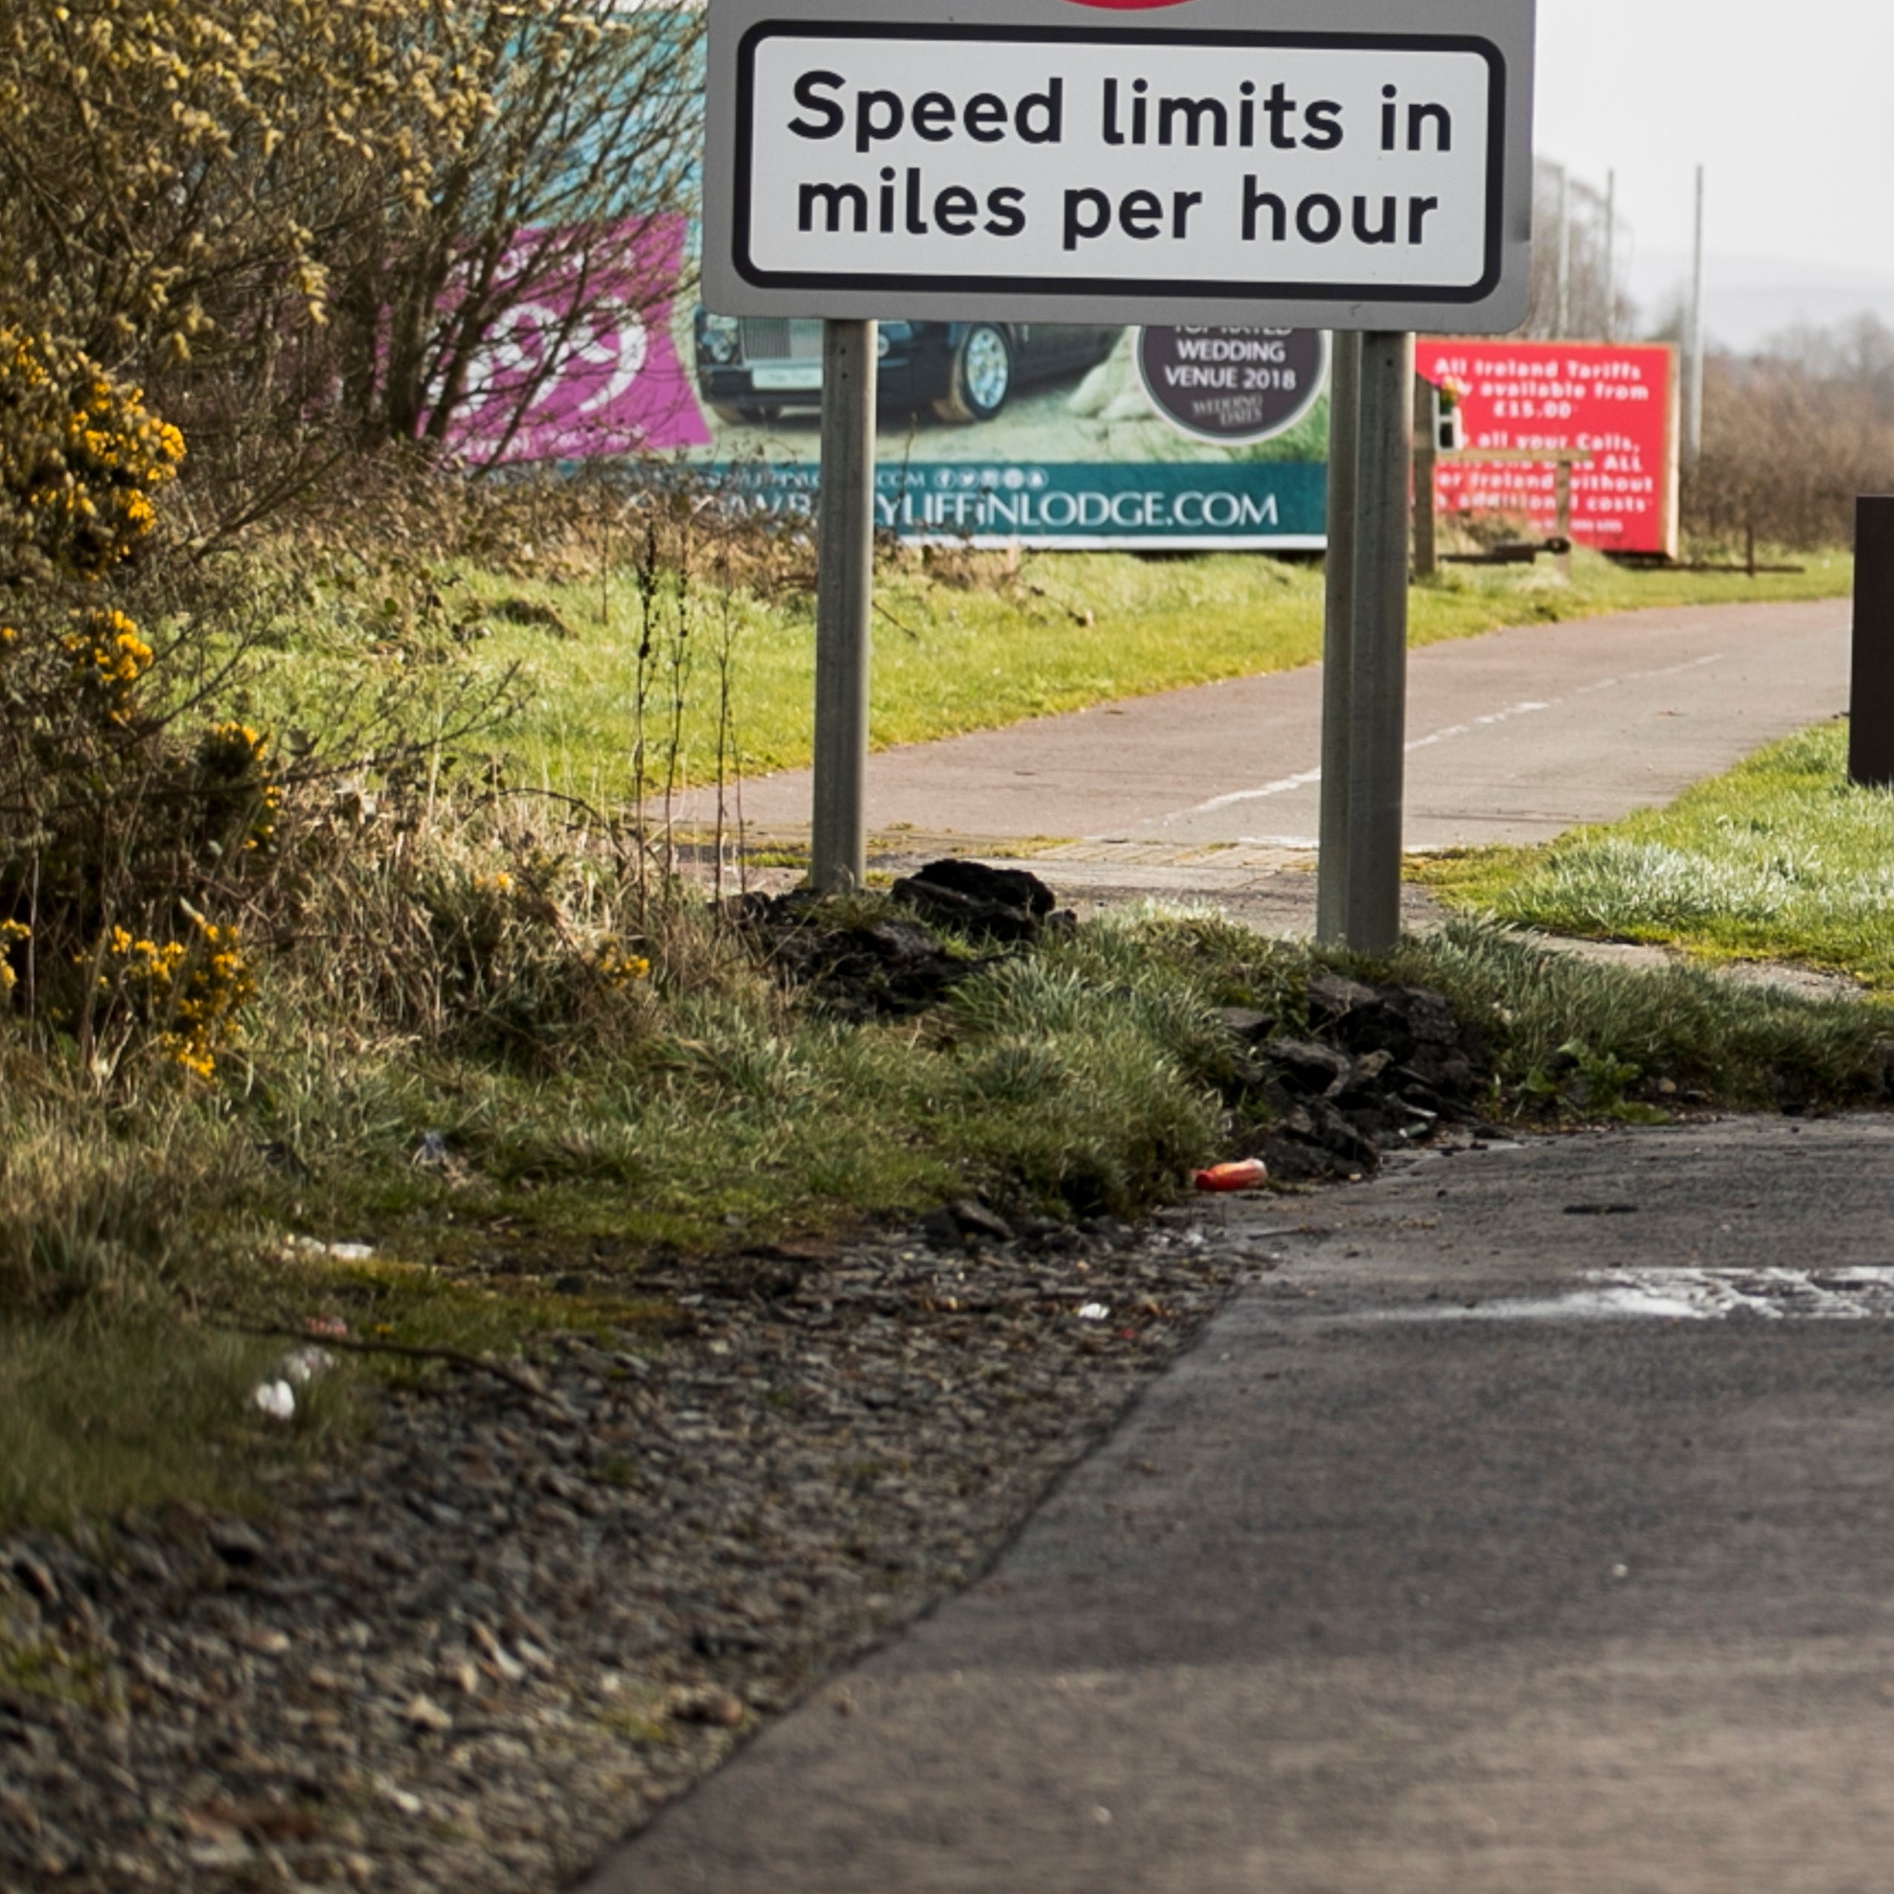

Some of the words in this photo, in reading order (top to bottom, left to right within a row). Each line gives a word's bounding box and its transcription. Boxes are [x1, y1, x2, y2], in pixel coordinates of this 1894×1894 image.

[787, 70, 1063, 153] Speed
[1102, 77, 1344, 151] limits
[1381, 83, 1452, 152] in
[798, 166, 1026, 238] miles
[1062, 186, 1203, 252] per
[1241, 174, 1438, 245] hour
[1177, 339, 1286, 362] WEDDING
[1164, 365, 1237, 388] VENUE
[1243, 367, 1296, 390] 2018
[1434, 358, 1467, 375] All
[1475, 359, 1558, 377] Ireland
[1566, 360, 1641, 379] Tariffs
[1480, 380, 1586, 398] available
[1594, 382, 1649, 400] from
[1478, 430, 1508, 448] all
[1516, 434, 1568, 449] your
[1468, 470, 1554, 490] Ireland
[1457, 491, 1579, 511] additionl
